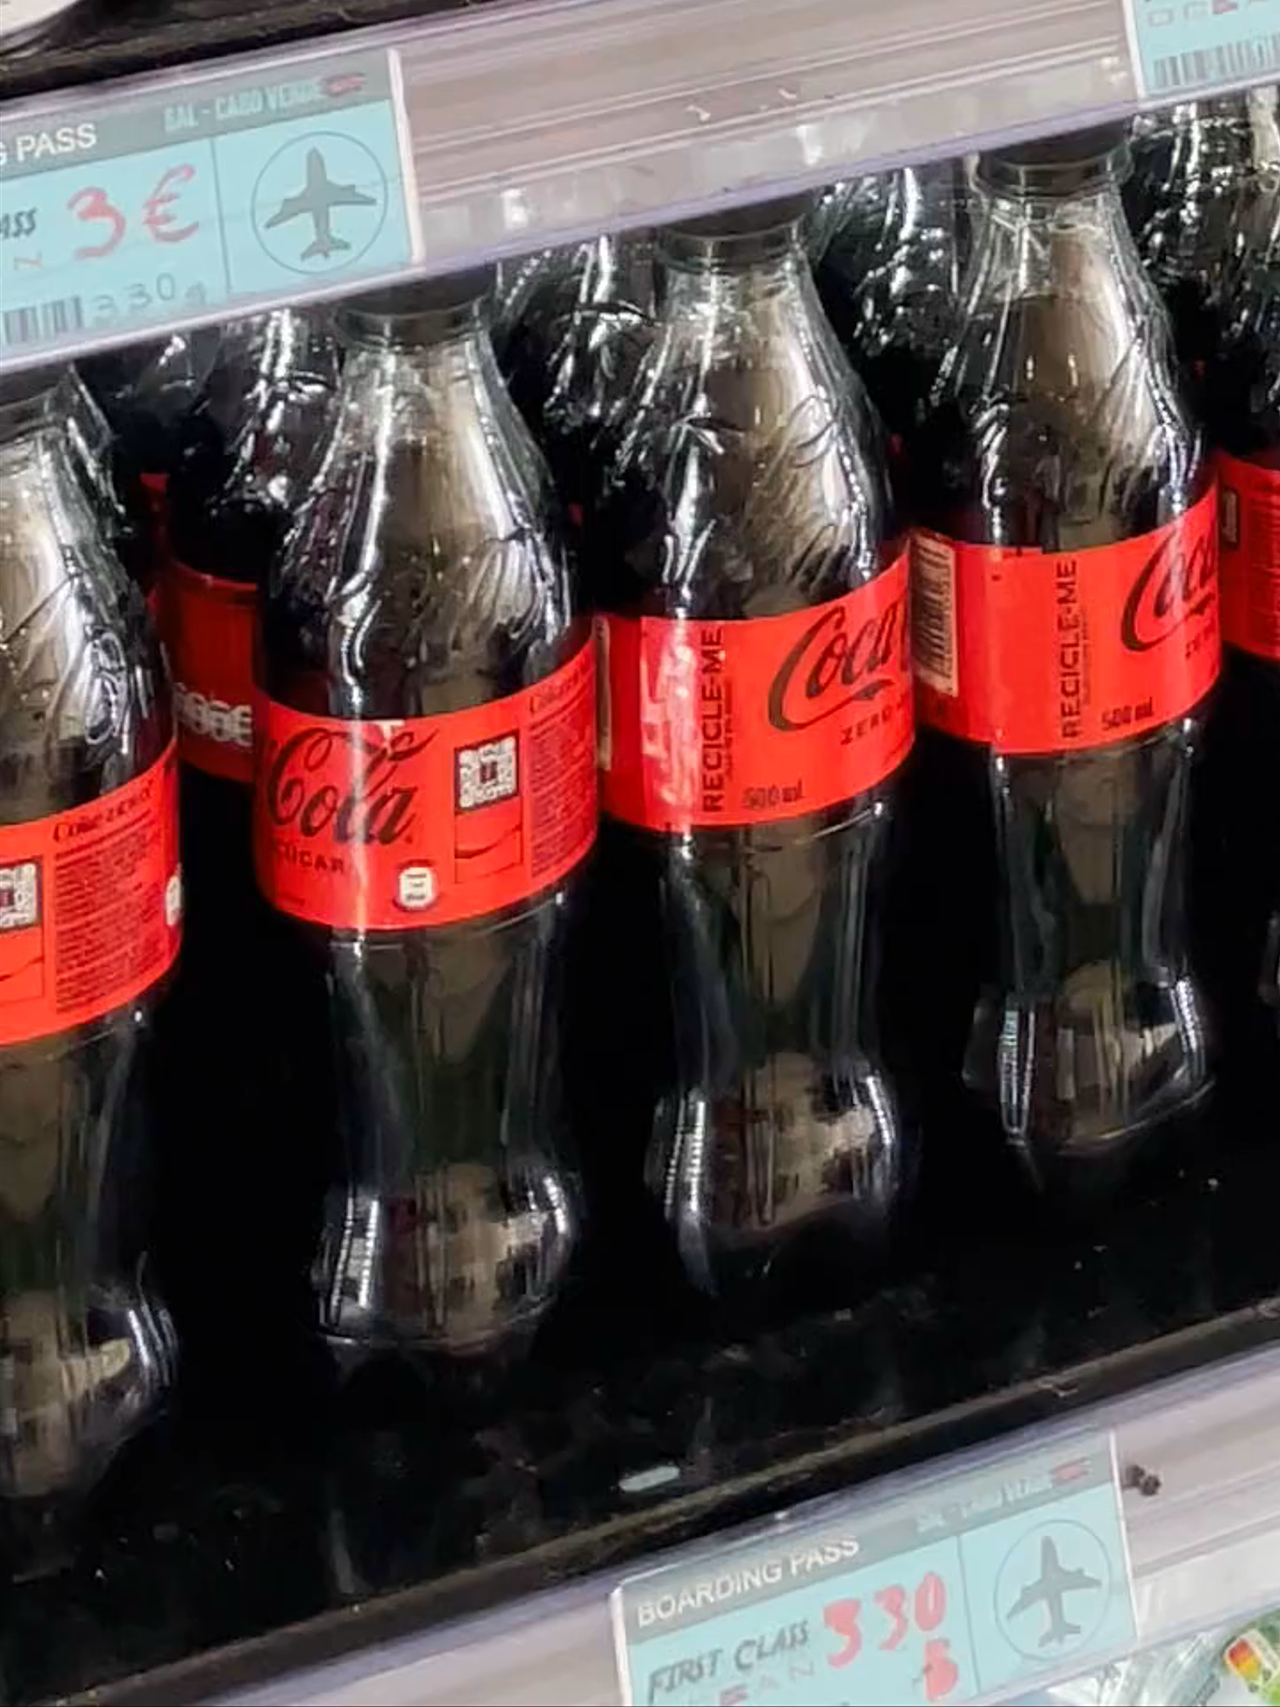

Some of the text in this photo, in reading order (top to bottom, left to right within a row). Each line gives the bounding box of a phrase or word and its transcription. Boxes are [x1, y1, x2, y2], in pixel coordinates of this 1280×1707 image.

[17, 122, 98, 162] PASS
[1061, 560, 1079, 738] RECICLE-ME
[702, 627, 726, 814] RECICLE-ME
[840, 709, 894, 747] ZERO
[636, 1535, 860, 1629] BOARDING PASS
[647, 1619, 809, 1705] FIRST CLASS
